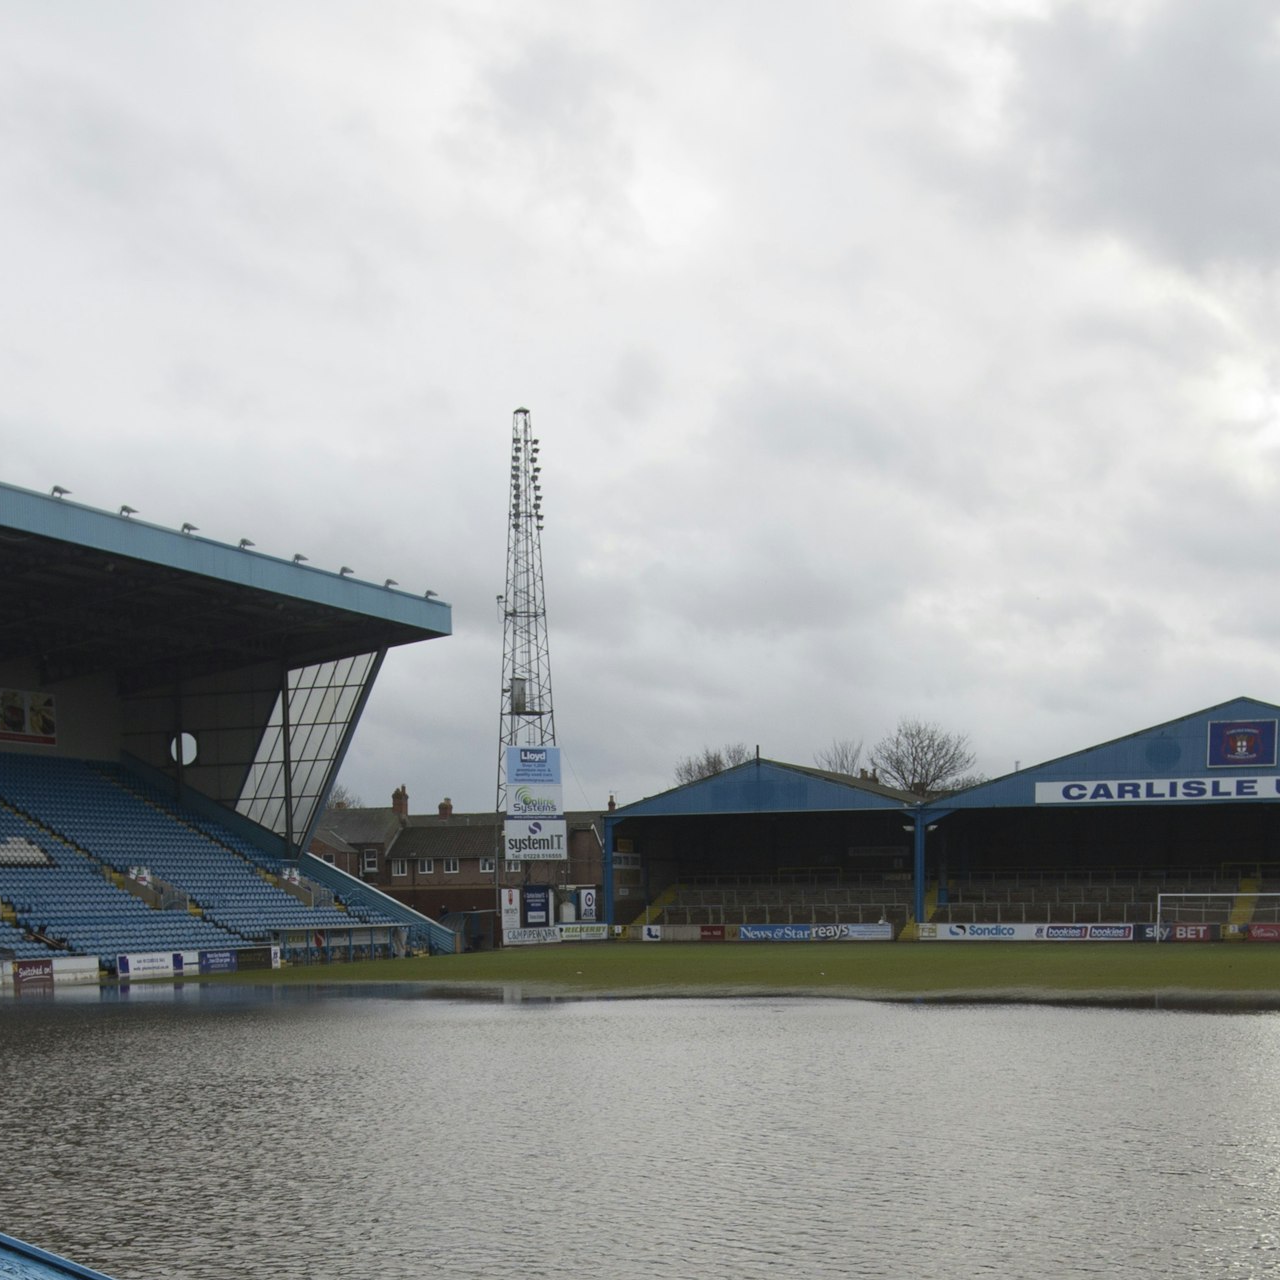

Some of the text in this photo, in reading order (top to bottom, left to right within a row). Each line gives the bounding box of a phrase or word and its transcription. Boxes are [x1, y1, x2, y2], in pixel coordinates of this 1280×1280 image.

[521, 751, 546, 761] Lloyd
[1062, 780, 1257, 801] CARLISLE
[513, 803, 557, 813] Systems
[740, 926, 810, 939] News & Star
[812, 924, 848, 939] reays
[969, 925, 1015, 936] Sondico
[1048, 928, 1080, 937] bookies
[1091, 928, 1124, 937] bookies
[1176, 926, 1207, 938] BET
[18, 965, 43, 978] Switched
